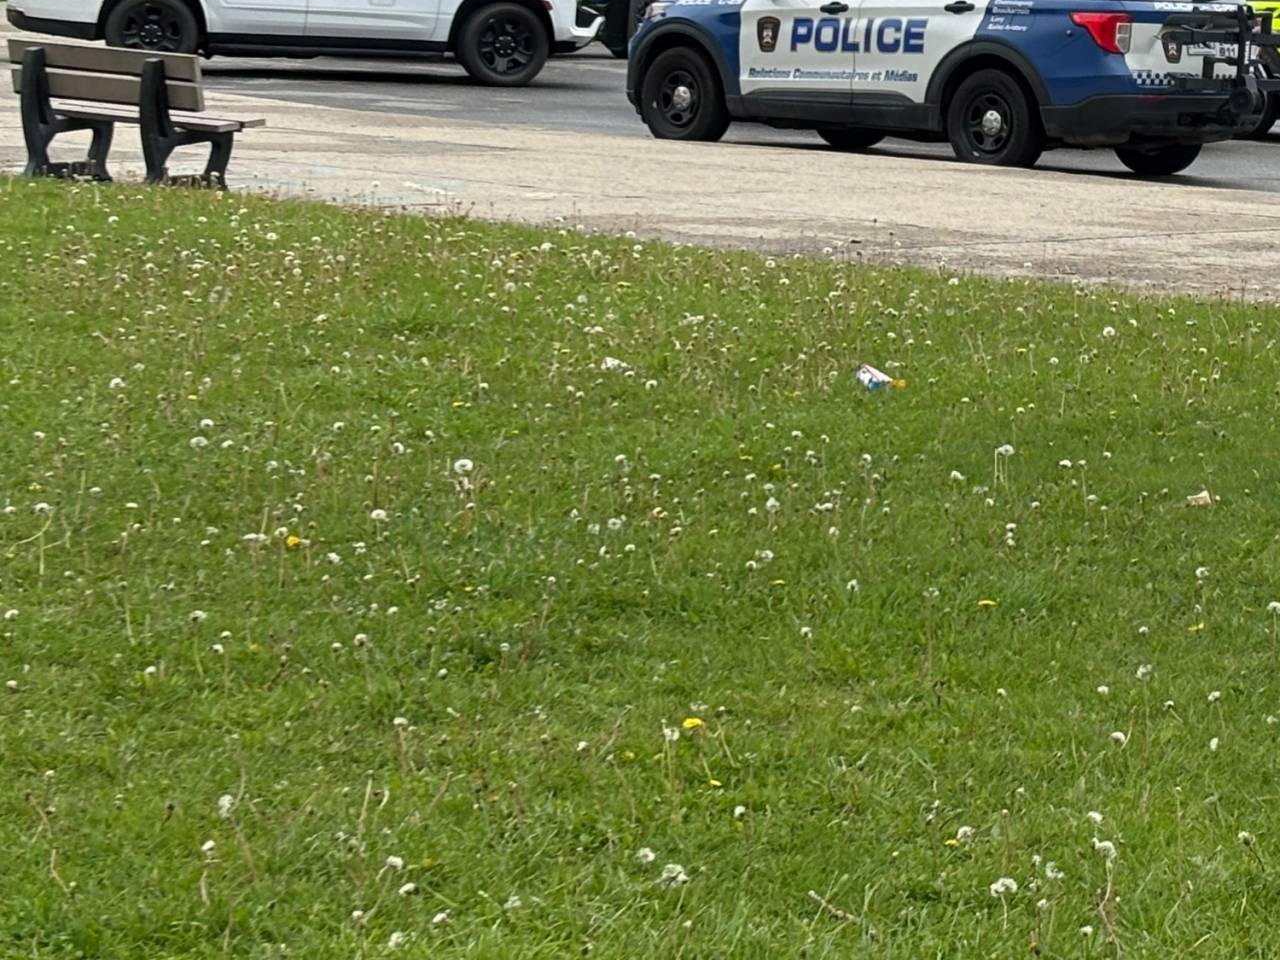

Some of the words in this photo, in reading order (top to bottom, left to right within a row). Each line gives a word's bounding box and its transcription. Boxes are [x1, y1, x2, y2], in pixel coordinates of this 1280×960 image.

[790, 16, 929, 54] POLICE
[749, 67, 790, 79] Relations
[792, 68, 869, 81] Communautaires
[871, 71, 882, 82] et
[883, 69, 919, 82] Médias
